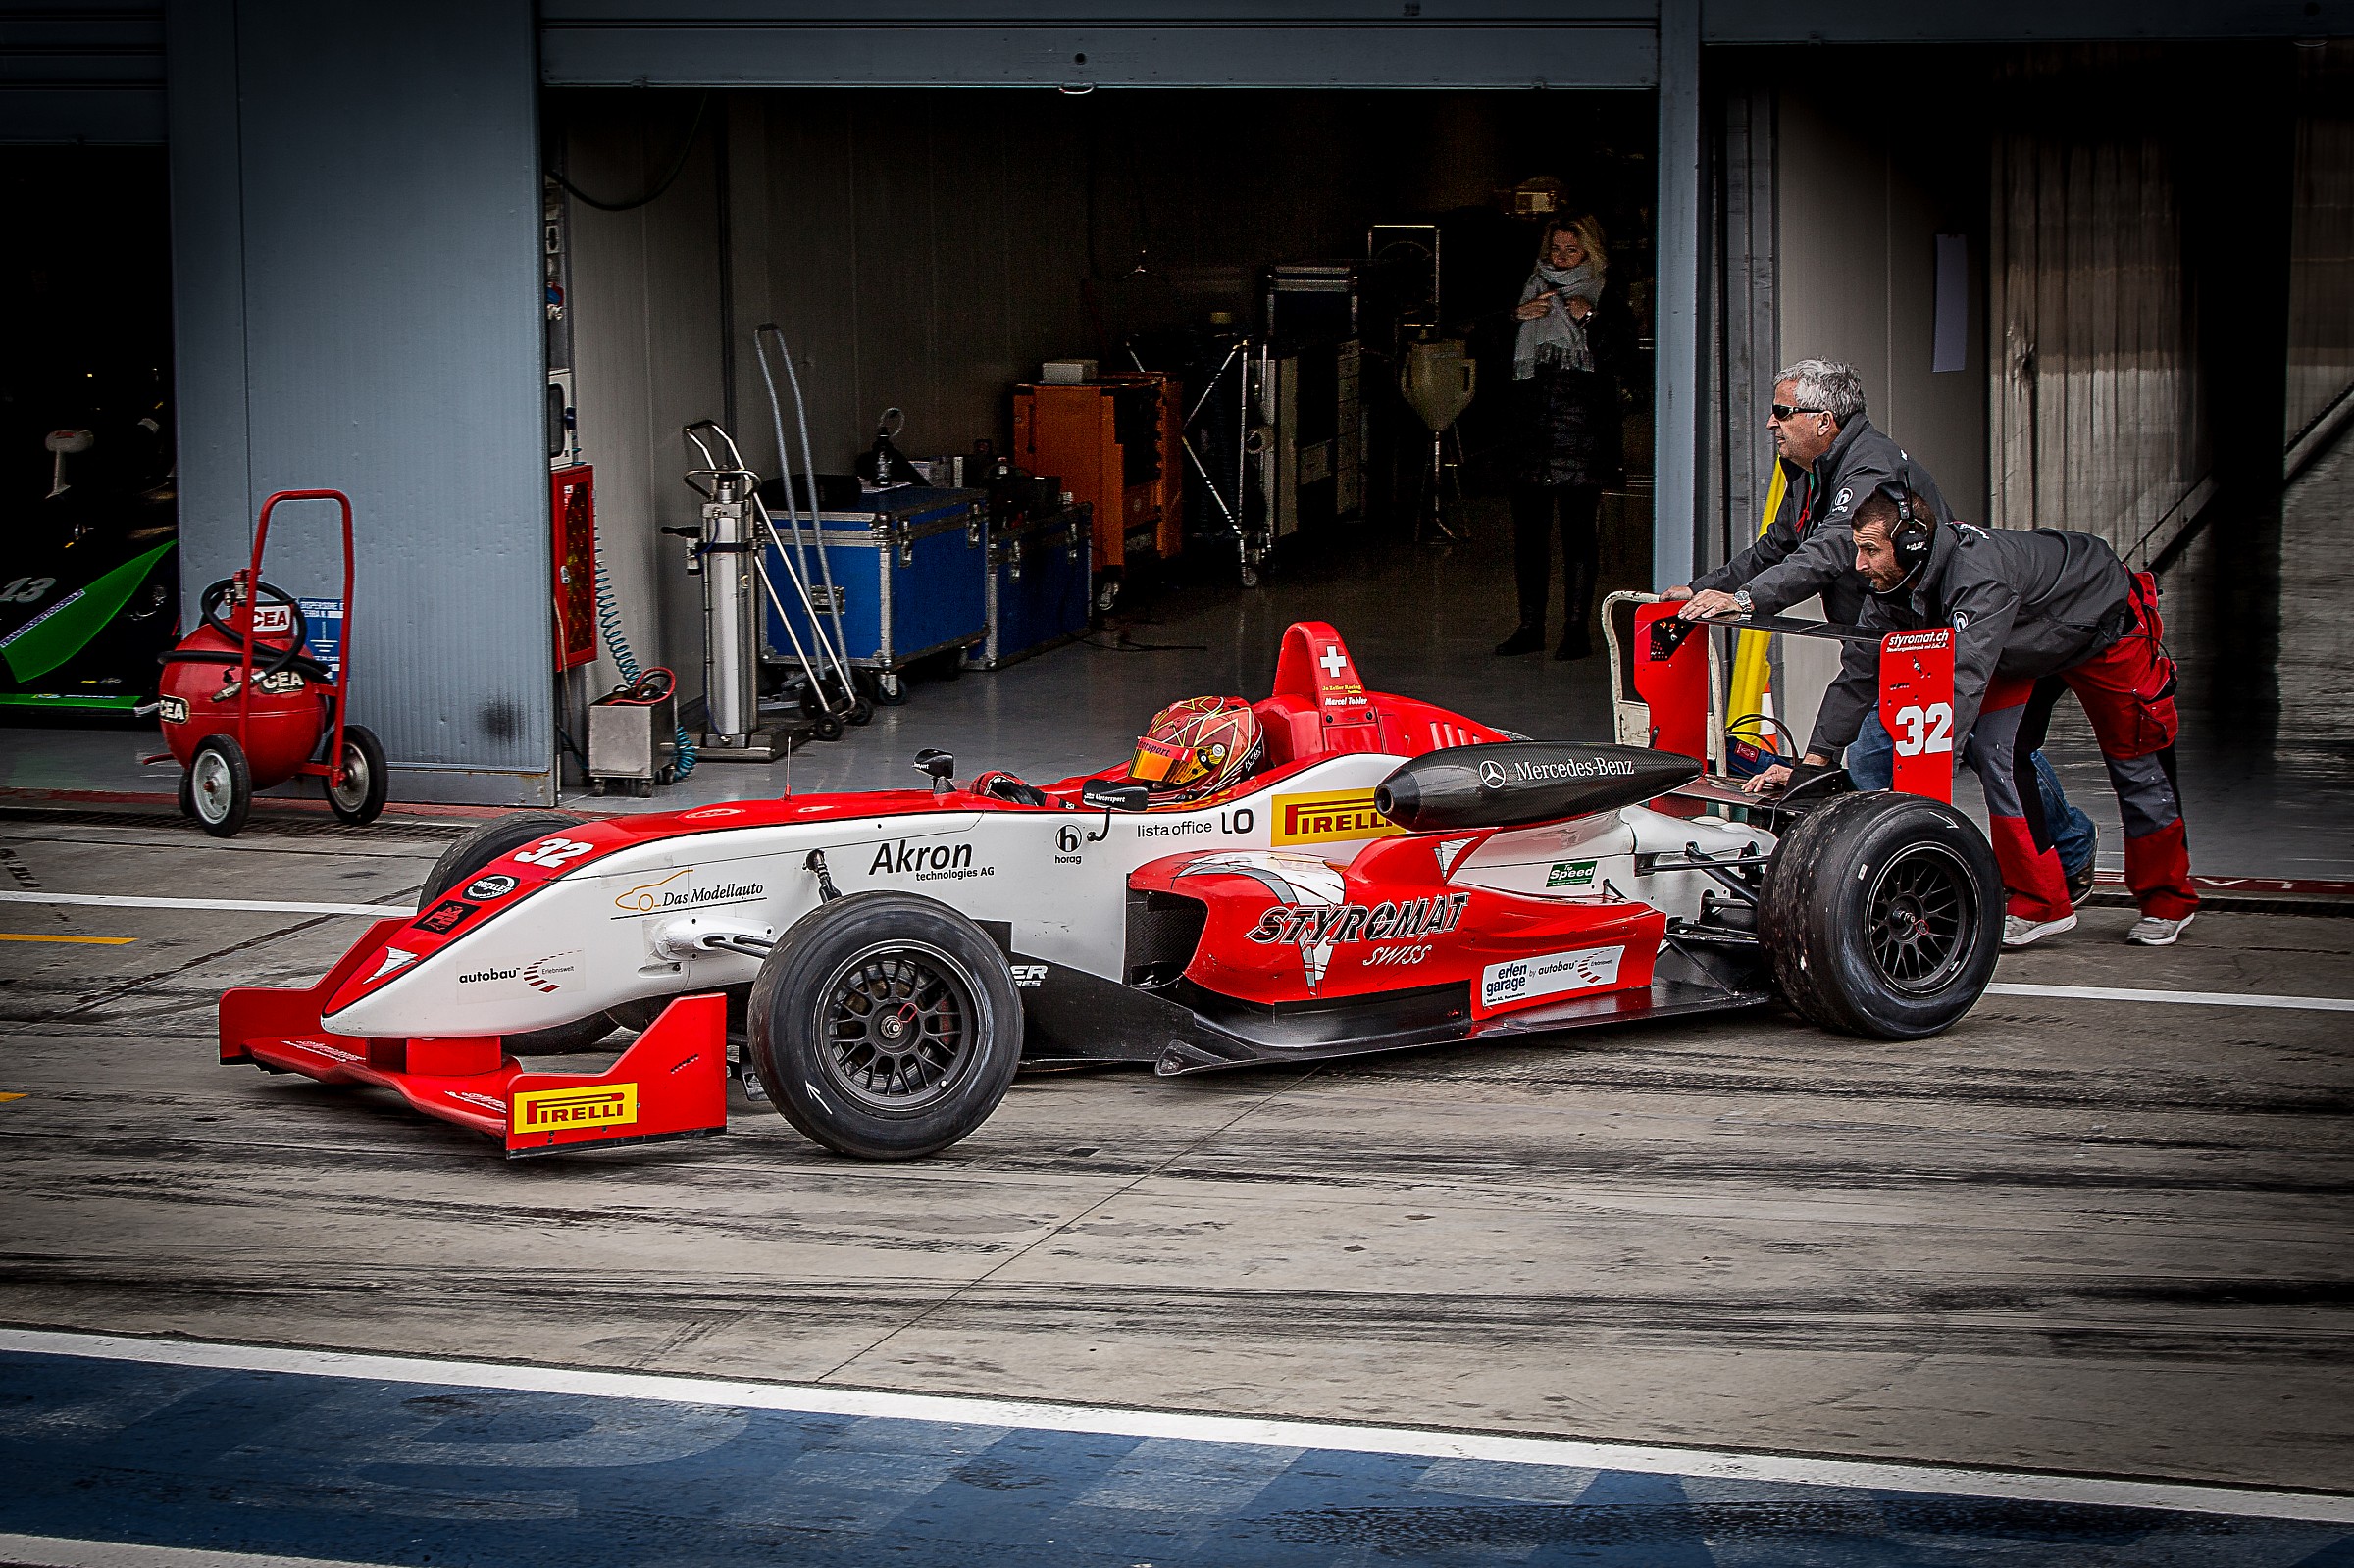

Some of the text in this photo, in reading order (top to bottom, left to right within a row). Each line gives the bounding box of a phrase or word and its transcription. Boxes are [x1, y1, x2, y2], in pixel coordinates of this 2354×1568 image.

[0, 577, 57, 603] 13
[252, 610, 288, 628] CEA
[1888, 629, 1950, 648] styromat.ch
[262, 671, 305, 688] CEA
[1325, 696, 1368, 706] Marcel Tobler
[1895, 702, 1953, 757] 32
[1514, 757, 1635, 781] Mercedes-Benz
[1137, 808, 1254, 838] lista office LO
[513, 837, 595, 869] 32
[868, 839, 973, 876] Akron
[1054, 854, 1082, 864] horag
[915, 866, 995, 882] technologies AG
[1549, 866, 1595, 880] Speed
[662, 882, 764, 907] Das Modellauto
[1244, 892, 1471, 946] STYROMAT
[1362, 944, 1433, 966] SWISS
[459, 965, 575, 984] autobau Erlebniswelt
[1498, 960, 1575, 979] erlen by autobau
[1486, 976, 1526, 997] garage
[526, 1091, 625, 1125] PIRELLI
